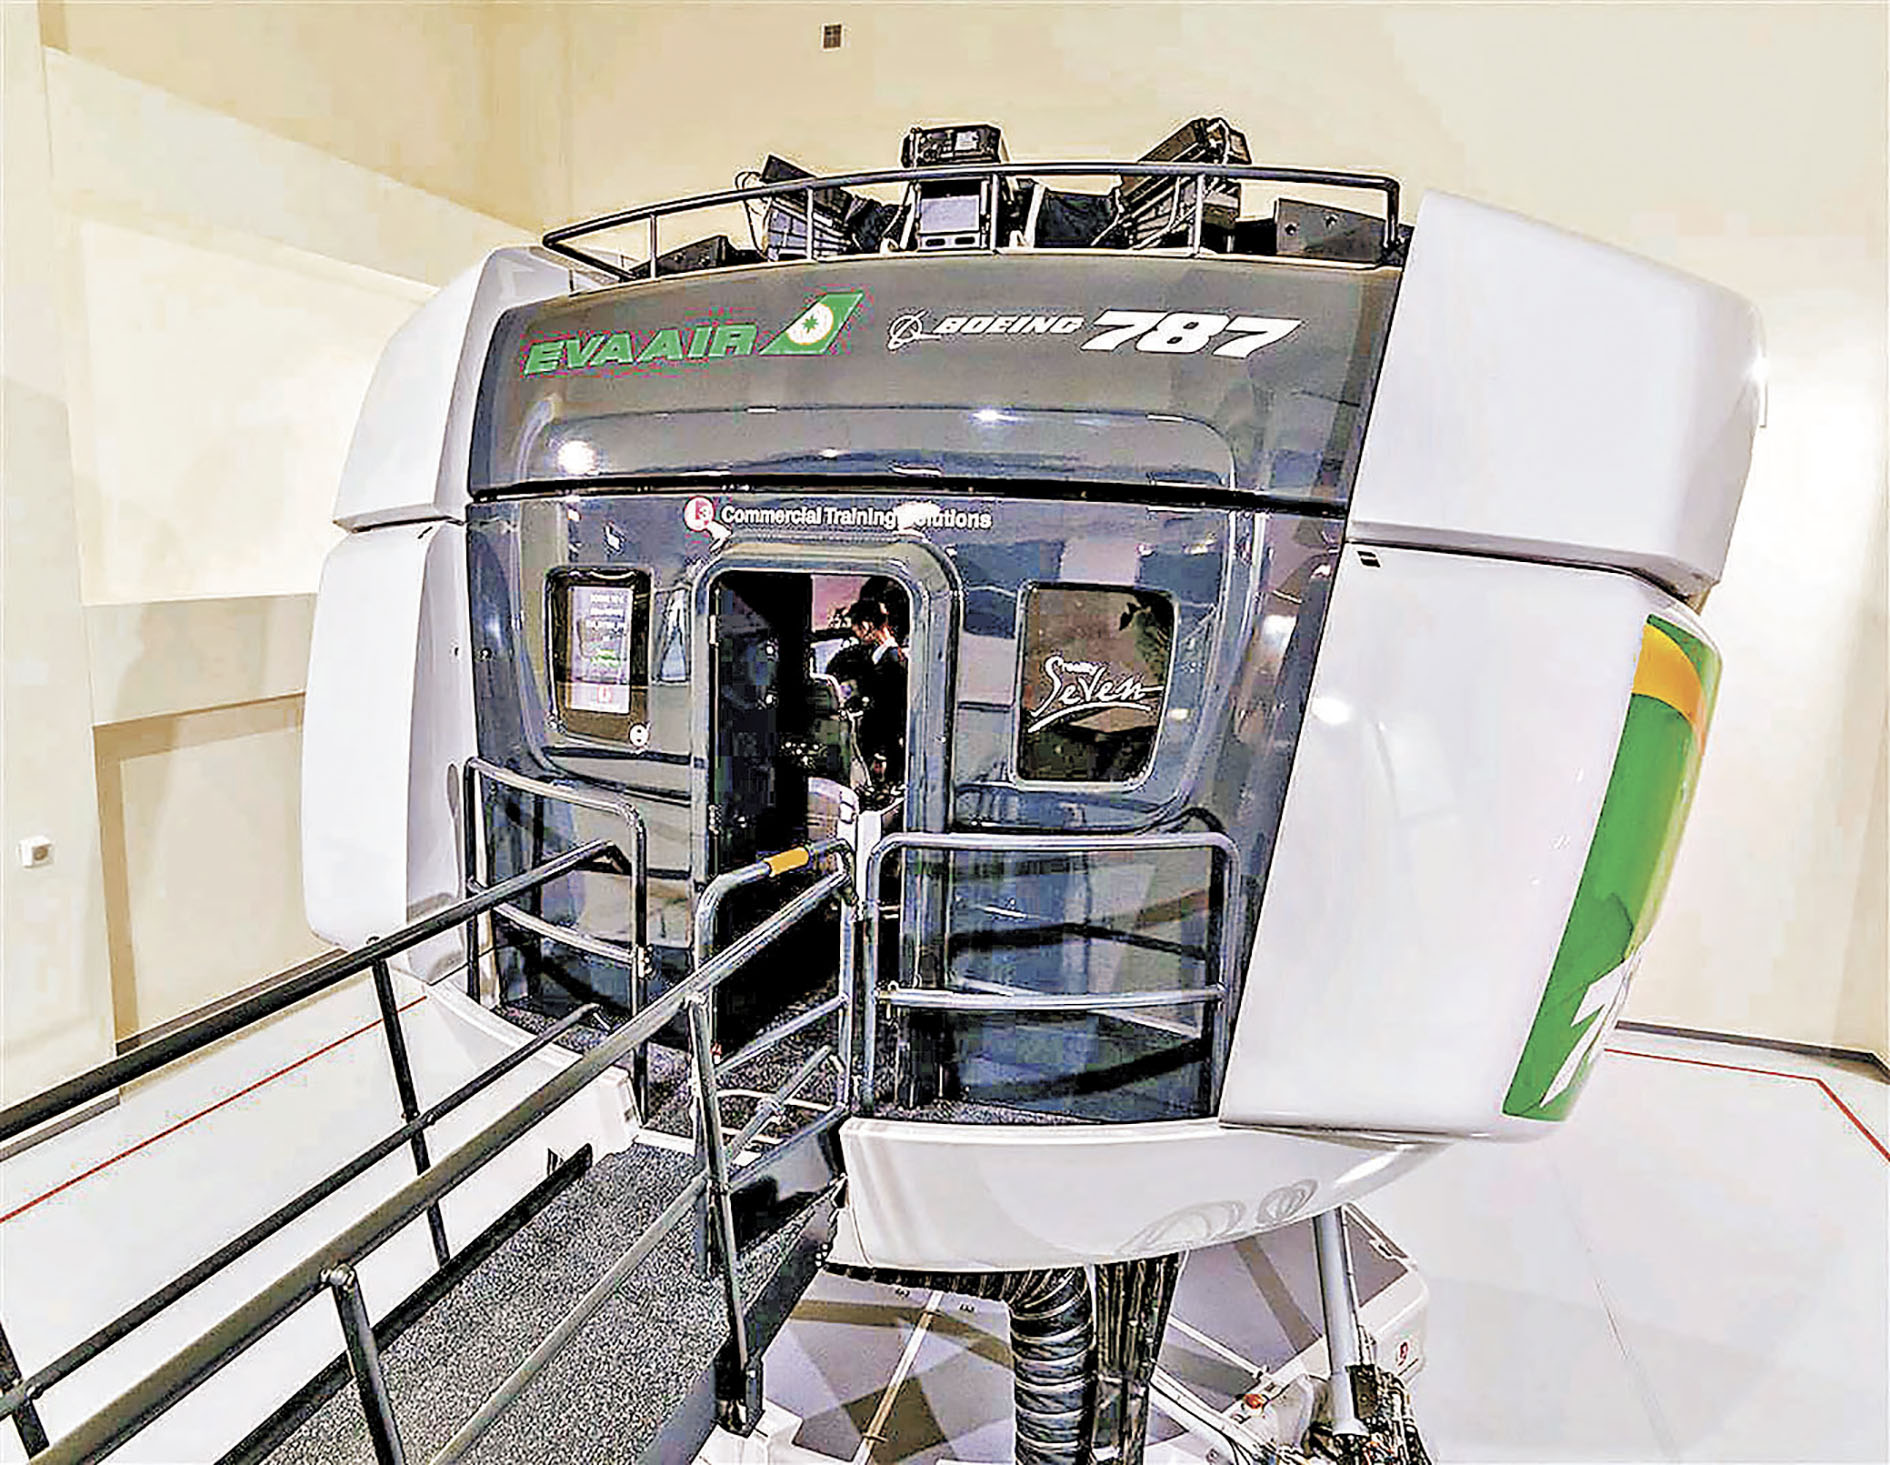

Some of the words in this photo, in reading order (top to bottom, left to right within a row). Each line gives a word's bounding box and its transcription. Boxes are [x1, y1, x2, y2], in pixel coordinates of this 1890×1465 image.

[933, 314, 1086, 334] BOEING
[1080, 309, 1302, 359] 787
[720, 505, 822, 525] Commercial
[823, 506, 897, 530] Training
[899, 506, 993, 530] olutions
